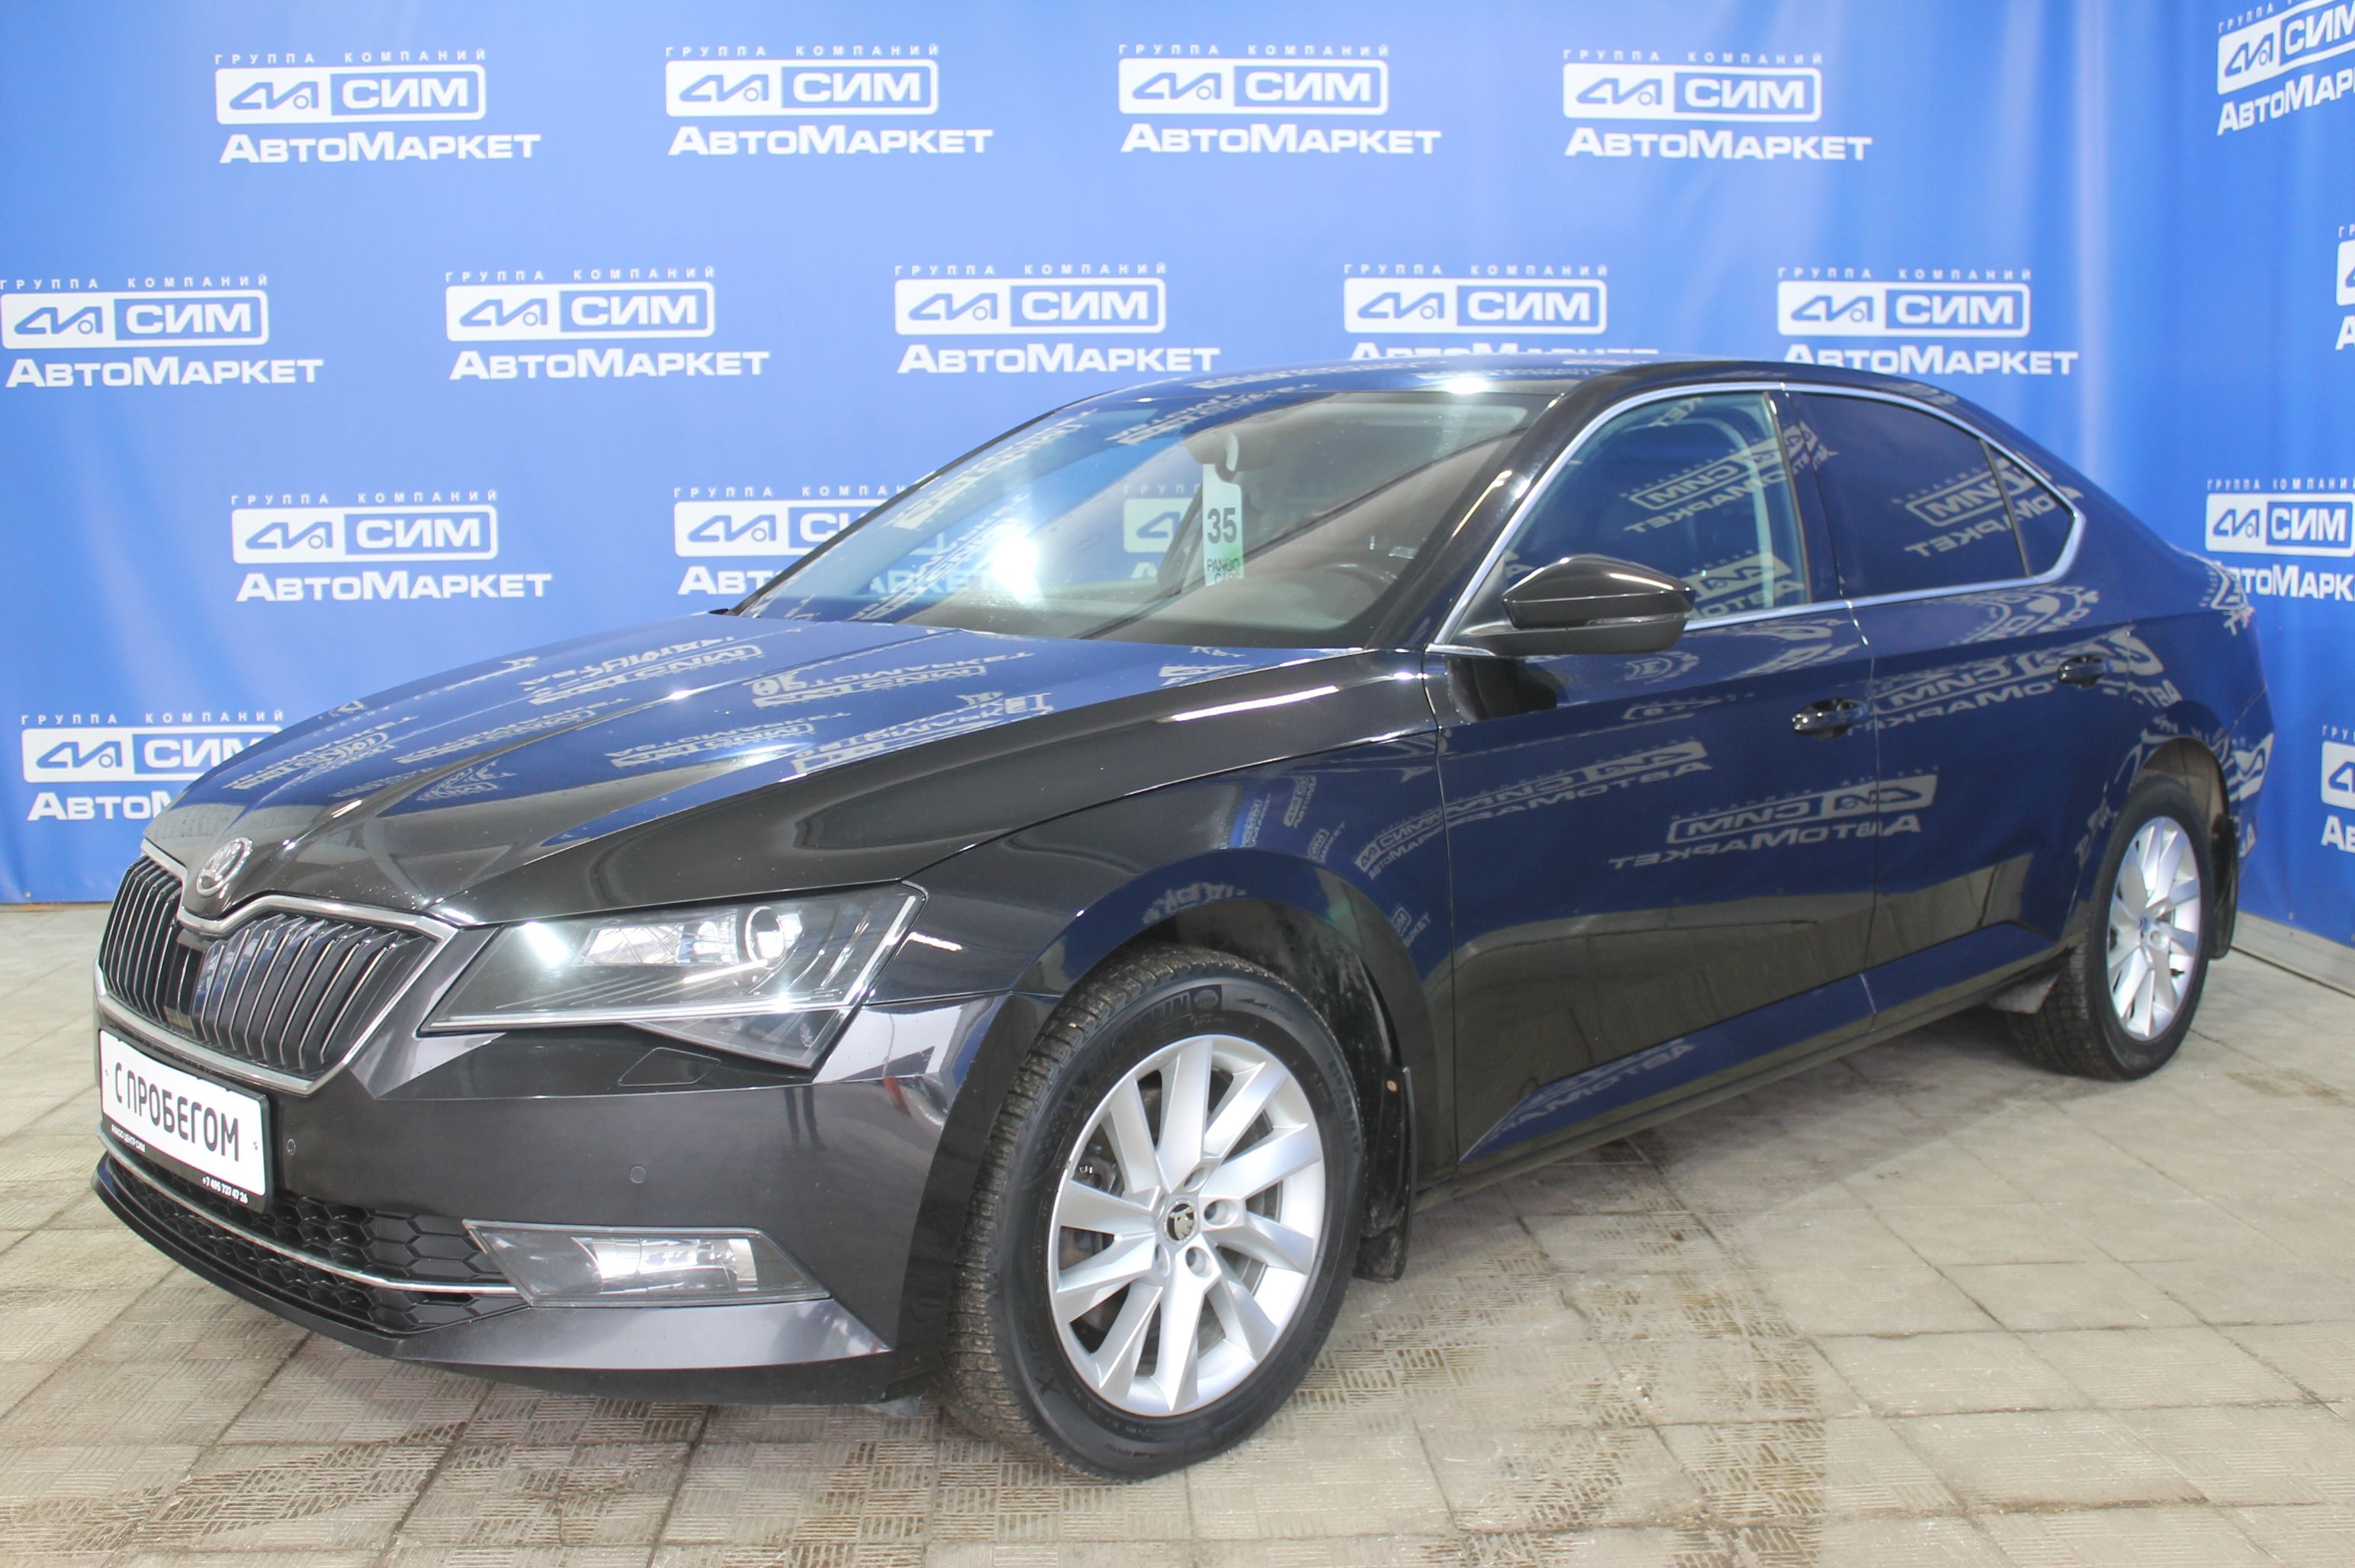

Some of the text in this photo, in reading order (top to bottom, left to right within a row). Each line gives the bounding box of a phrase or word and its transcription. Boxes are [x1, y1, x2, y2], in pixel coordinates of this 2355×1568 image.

[2218, 2, 2274, 34] ГРУППА
[214, 48, 485, 65] ГРУППА КОМПАНИЙ
[665, 43, 939, 57] ГРУППА КОМПАНИЙ
[1119, 43, 1389, 56] ГРУППА КОМПАНИЙ
[1563, 49, 1823, 65] ГРУППА КОМПАНИЙ
[342, 77, 468, 108] СИМ
[792, 72, 920, 102] СИМ
[1245, 71, 1371, 101] СИМ
[1685, 78, 1805, 109] СИМ
[0, 274, 268, 290] ГРУППА КОМПАНИЙ
[445, 265, 715, 282] ГРУППА КОМПАНИЙ
[895, 262, 1166, 276] ГРУППА КОМПАНИЙ
[1344, 263, 1608, 276] ГРУППА КОМПАНИЙ
[1777, 268, 2032, 281] ГРУППА КОМПАНИЙ
[126, 303, 251, 334] СИМ
[570, 294, 697, 326] СИМ
[1021, 291, 1148, 320] СИМ
[1467, 291, 1590, 321] СИМ
[1896, 294, 2014, 324] СИМ
[231, 489, 496, 506] ГРУППА КОМПАНИЙ
[673, 487, 773, 498] ГРУППА
[2207, 477, 2355, 490] ГРУППА КОМПАНИ
[356, 518, 480, 548] СИМ
[1207, 508, 1236, 544] 35
[2271, 508, 2347, 541] СИМ
[21, 709, 283, 725] ГРУППА КОМПАНИЙ
[115, 1062, 239, 1162] С ПРОБЕГОМ
